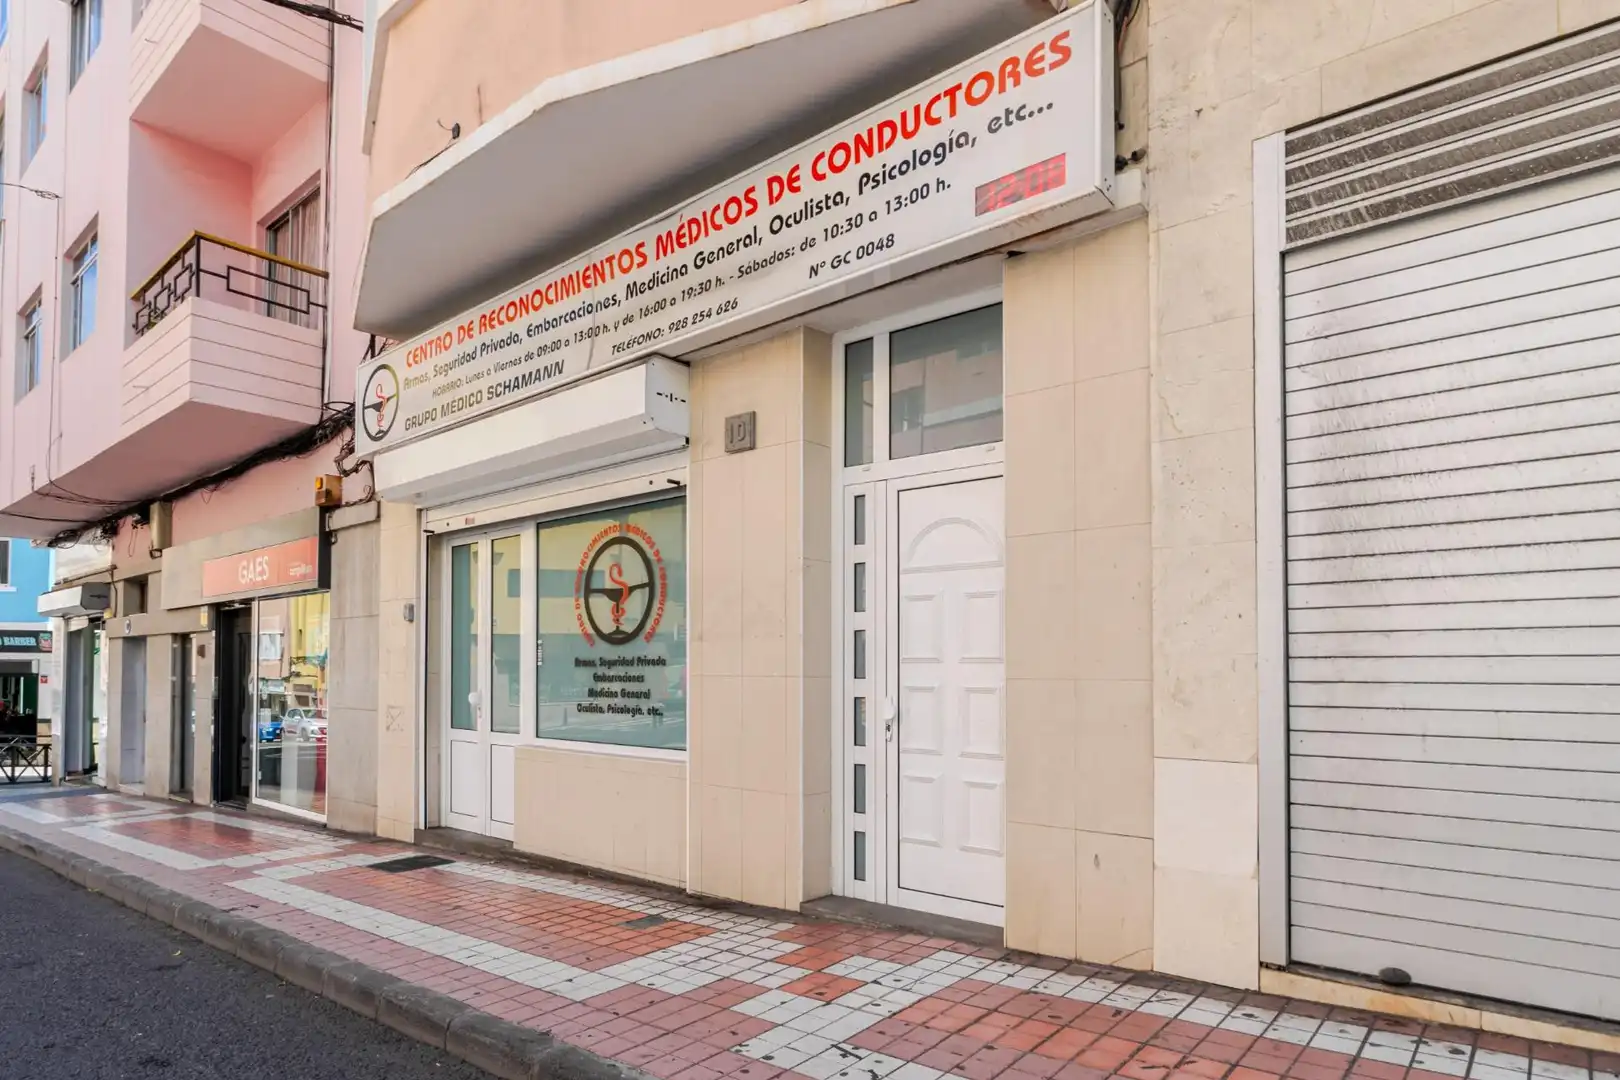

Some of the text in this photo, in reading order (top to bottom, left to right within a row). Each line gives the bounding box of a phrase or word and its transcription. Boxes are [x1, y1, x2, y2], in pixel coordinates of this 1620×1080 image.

[406, 30, 1072, 368] CENTRO DE RECONOCIMIENTOS MÉDICOS DE CONDUCTORES
[403, 101, 1053, 391] Armas, Seguridad Privada, Embarcaciones, Medicina General, Oculista, Psicología, etc...
[830, 250, 851, 270] GC
[856, 233, 895, 261] 0048
[432, 379, 464, 399] HORARIO:
[465, 371, 485, 385] Lunes
[486, 367, 492, 376] a
[493, 356, 522, 373] Viernes
[524, 350, 535, 362] de
[537, 339, 562, 358] 09:00
[564, 338, 570, 347] a
[573, 322, 600, 341] 13:00
[602, 321, 611, 335] h.
[613, 320, 620, 332] y
[622, 313, 634, 327] de
[638, 298, 667, 318] 16:00
[669, 297, 676, 306] a
[681, 279, 712, 301] 19:30
[715, 275, 725, 288] h.
[737, 245, 795, 279] Sábados:
[800, 236, 816, 251] de
[823, 212, 864, 241] 10:30
[869, 210, 877, 222] a
[885, 184, 930, 215] 13:00
[936, 178, 951, 192] h.
[668, 316, 688, 334] 928
[691, 308, 712, 326] 254
[716, 297, 738, 316] 626
[405, 407, 437, 431] GRUPO
[487, 359, 565, 400] SCHAMANN
[238, 555, 269, 585] GAES
[593, 672, 645, 683] Embarcaciones
[599, 655, 635, 670] Seguridad
[636, 655, 666, 667] Privada
[588, 687, 651, 699] Medicina General
